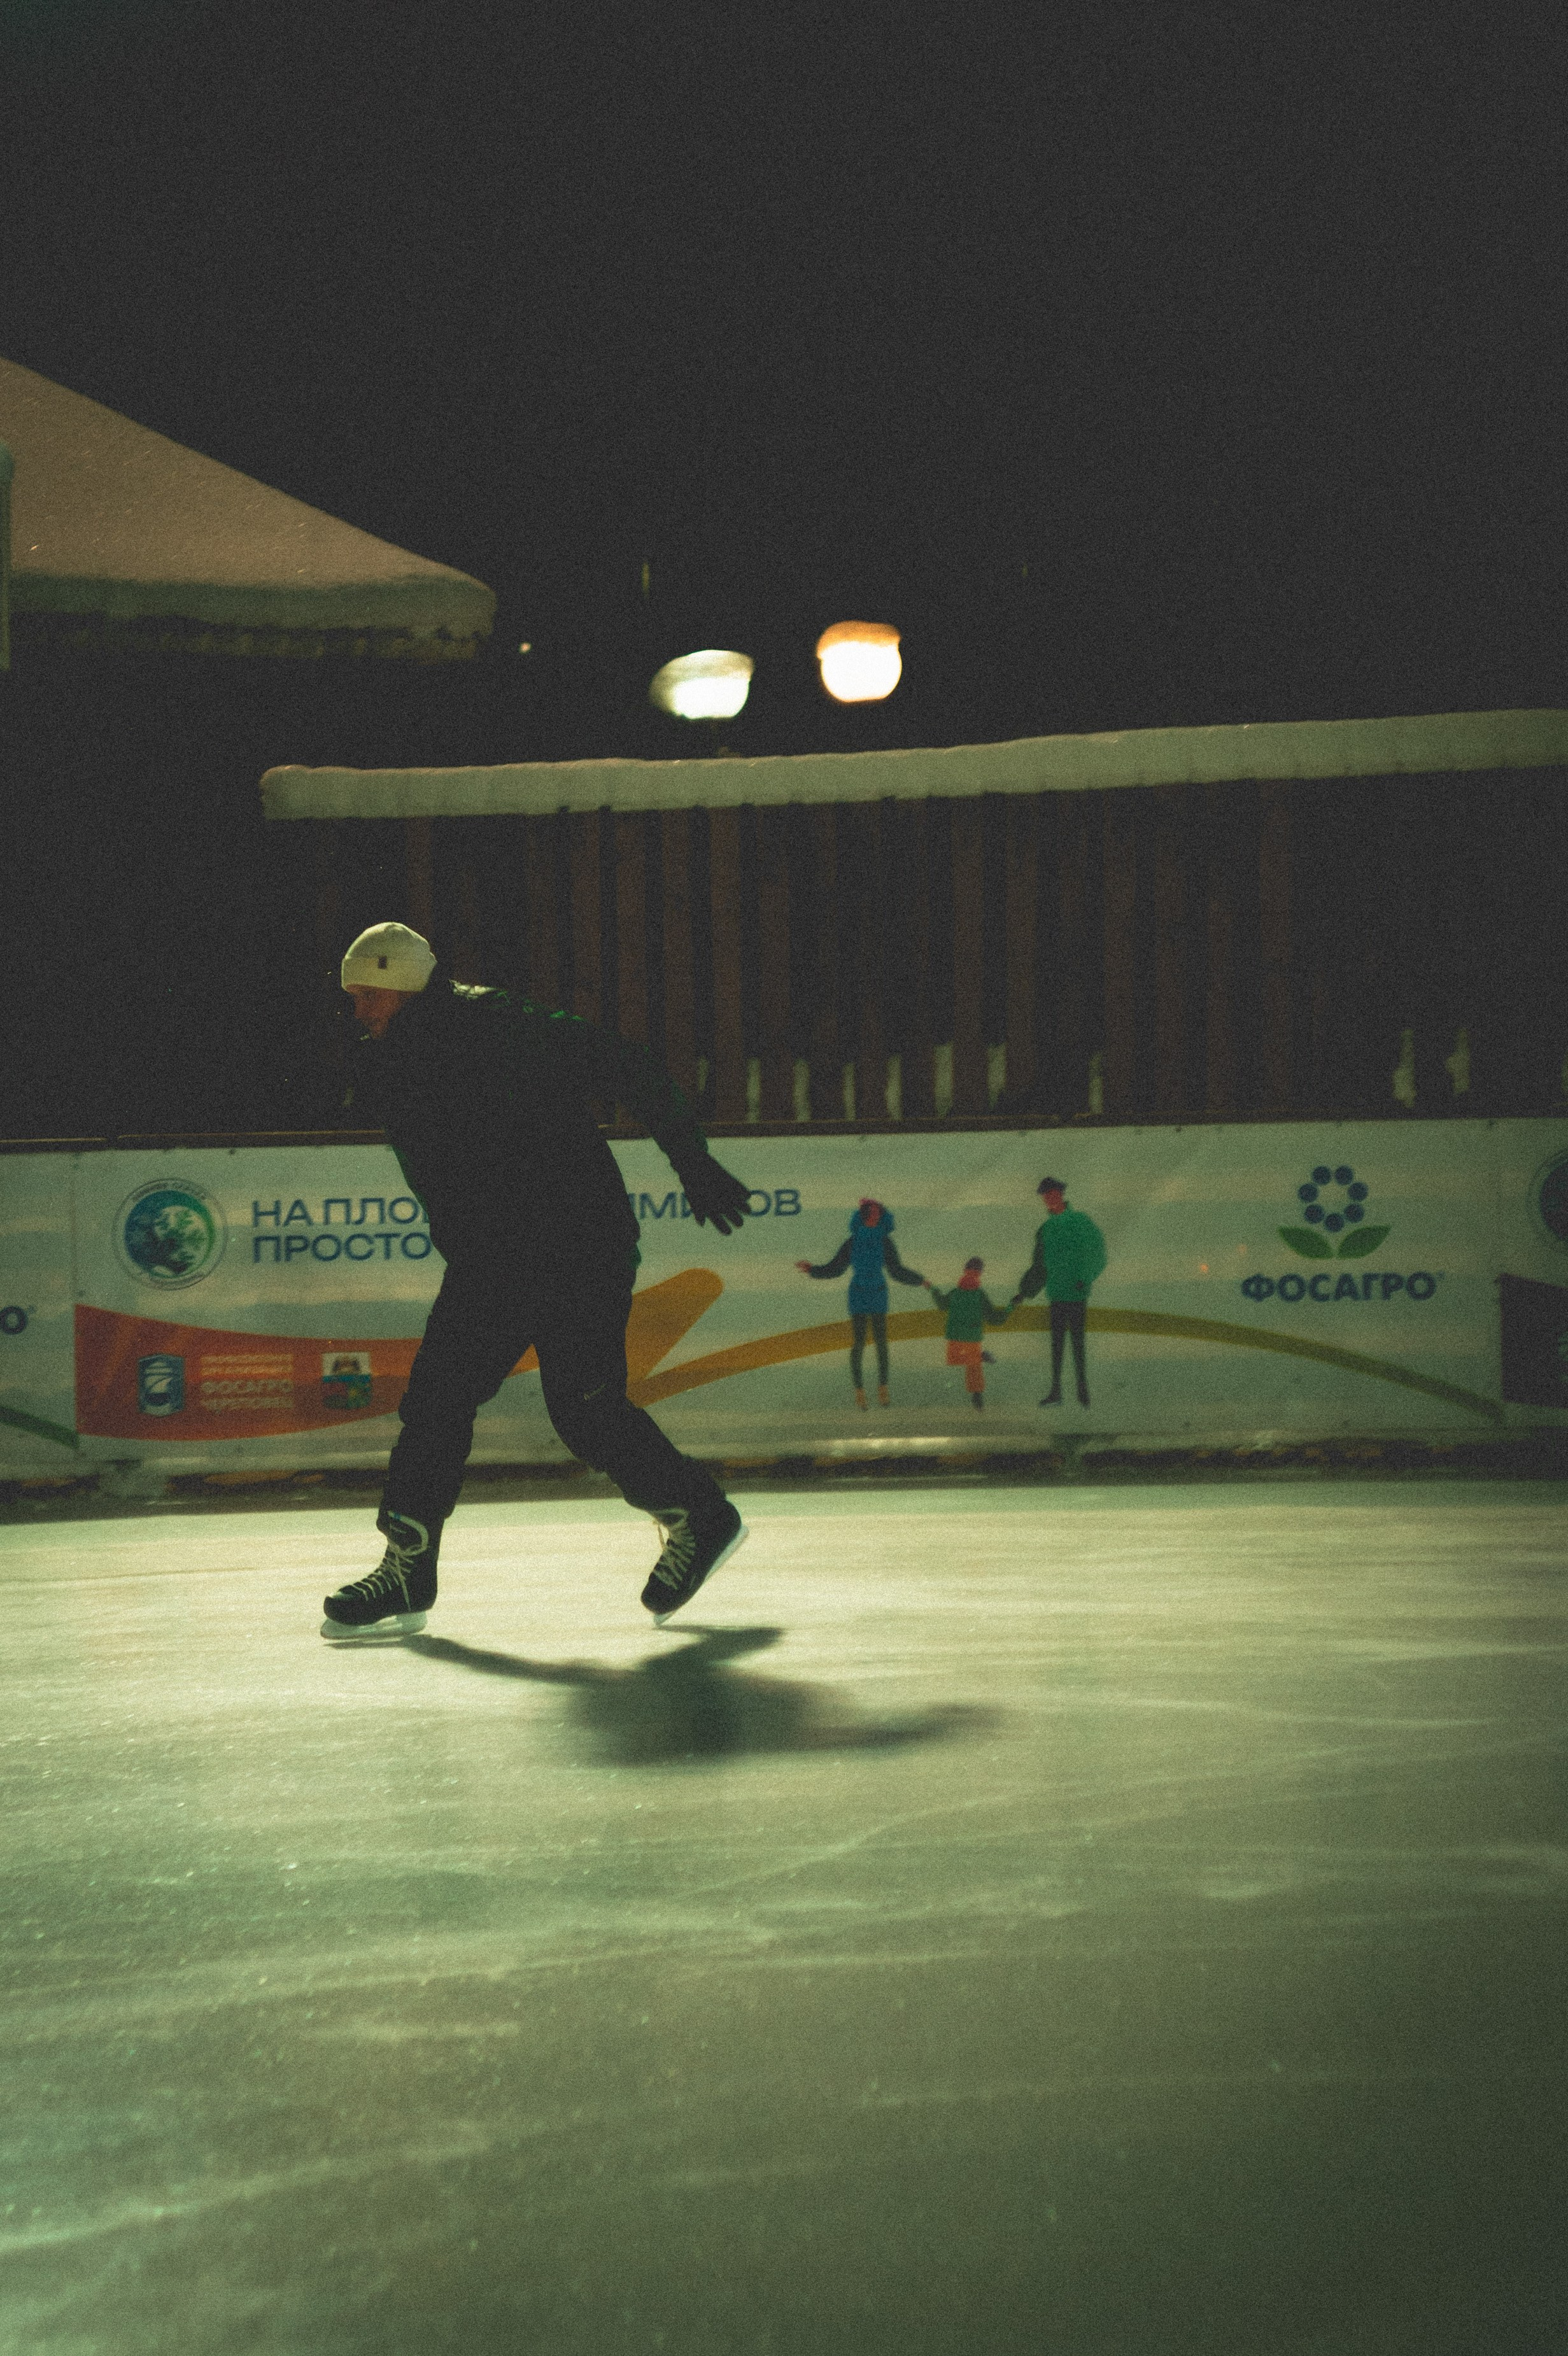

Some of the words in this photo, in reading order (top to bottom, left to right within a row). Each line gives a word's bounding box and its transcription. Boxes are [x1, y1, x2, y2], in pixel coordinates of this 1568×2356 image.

[252, 1199, 313, 1227] НА
[323, 1197, 430, 1225] ПЛО
[253, 1232, 432, 1264] ПРОСТО
[1241, 1271, 1437, 1302] ФОСАГРО
